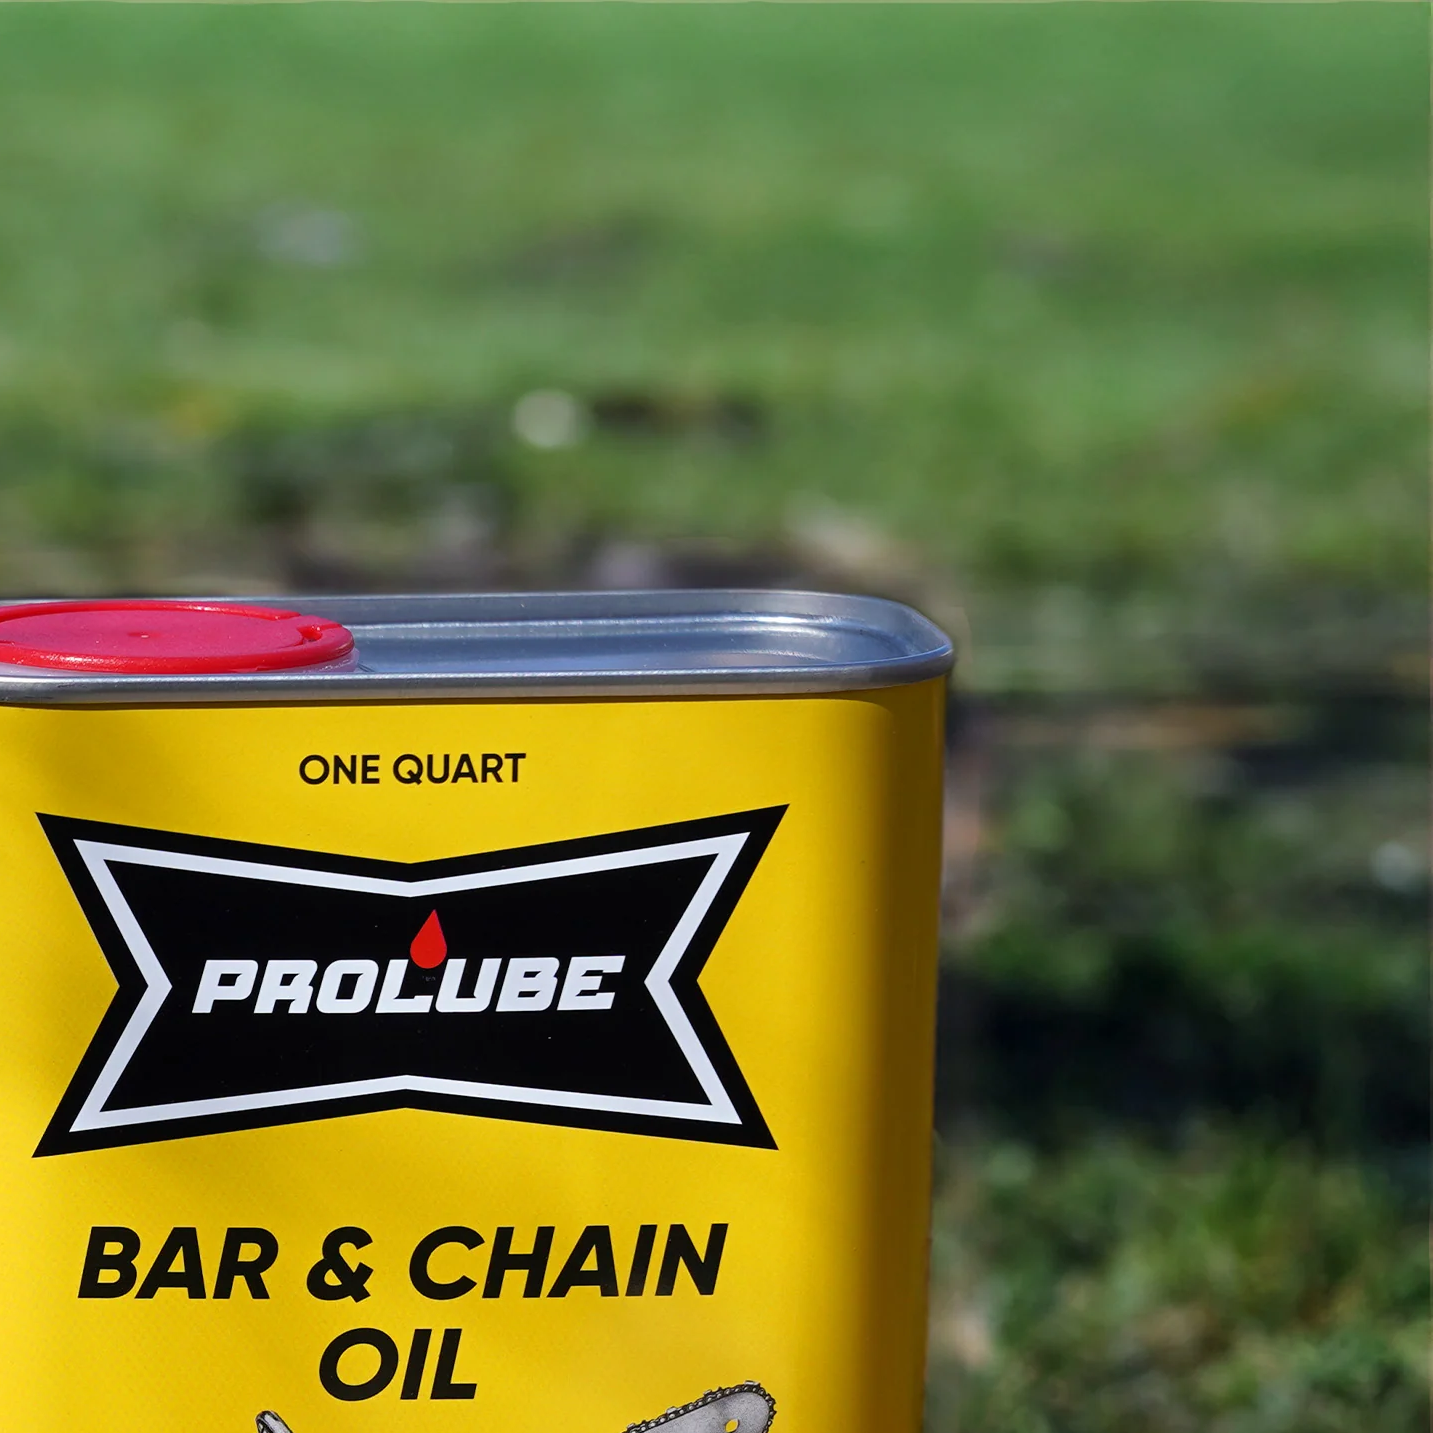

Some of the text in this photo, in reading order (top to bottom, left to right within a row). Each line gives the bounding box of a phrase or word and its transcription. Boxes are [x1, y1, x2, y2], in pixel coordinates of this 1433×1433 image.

[300, 753, 526, 784] ONE QUART
[192, 956, 625, 1013] PROLUBE
[78, 1224, 728, 1302] BAR & CHAIN
[319, 1328, 477, 1401] OIL
